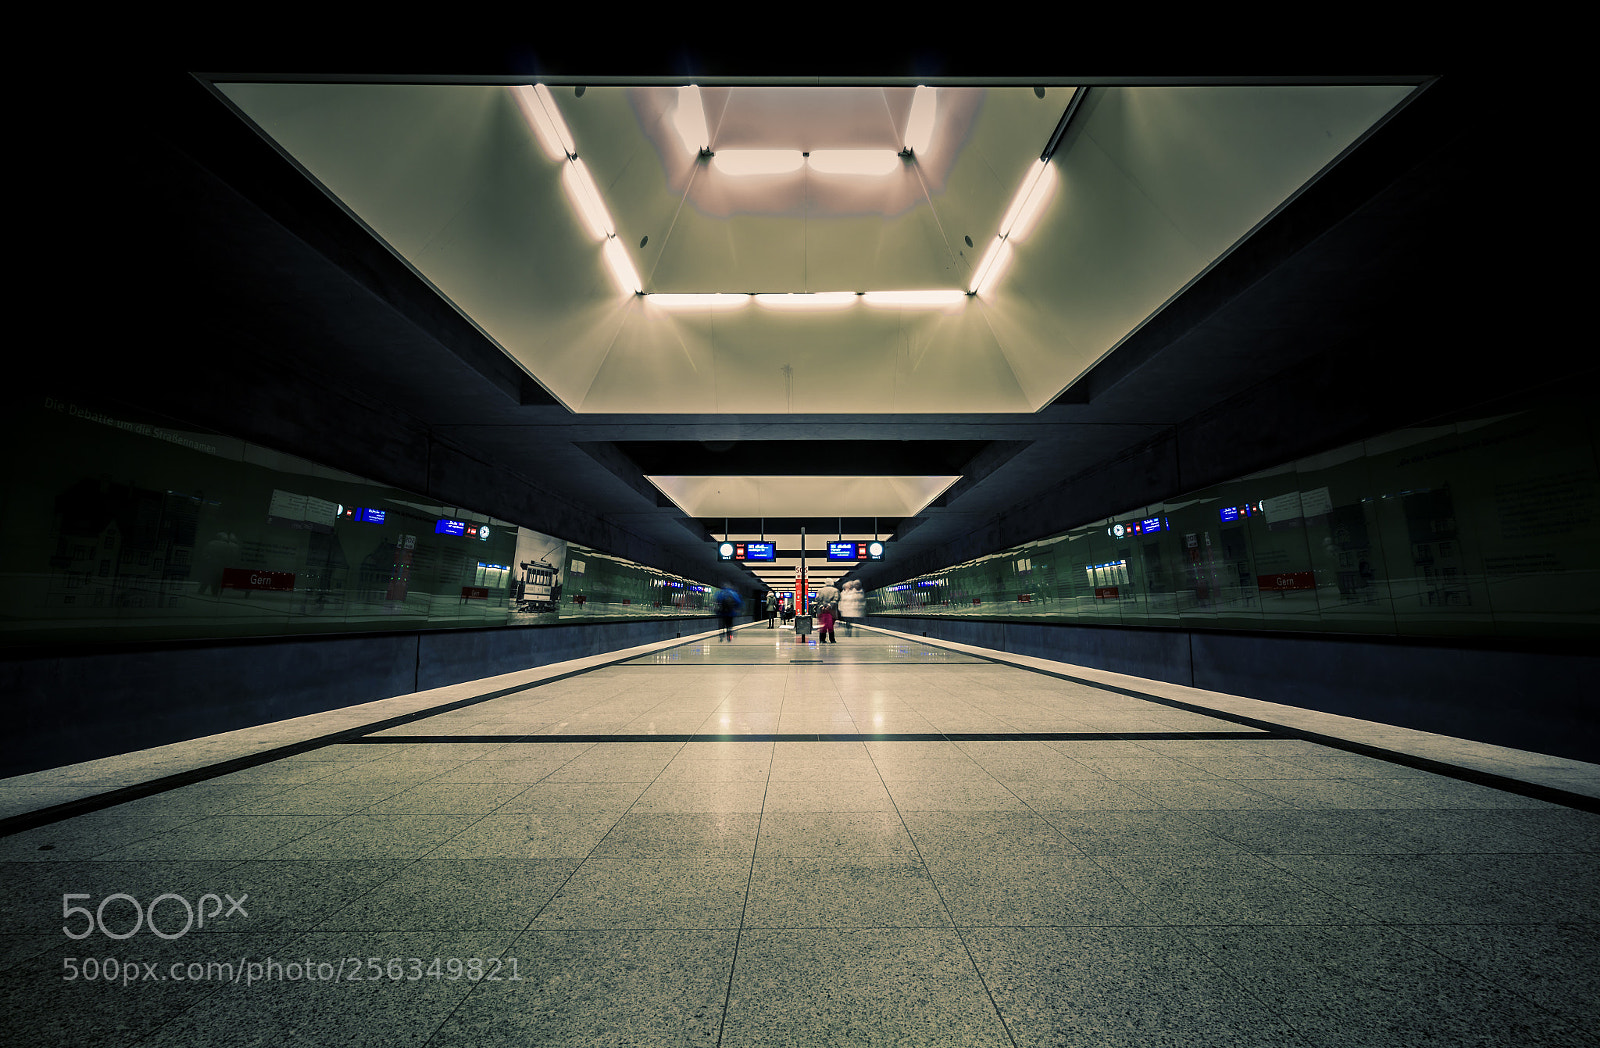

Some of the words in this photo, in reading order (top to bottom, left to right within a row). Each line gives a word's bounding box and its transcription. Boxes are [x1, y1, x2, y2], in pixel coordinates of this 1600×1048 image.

[44, 396, 64, 413] Die
[69, 403, 113, 426] Debatte
[116, 419, 134, 432] um
[135, 423, 152, 437] die
[153, 427, 216, 455] Straßennamen
[250, 574, 272, 585] Gern
[1276, 577, 1295, 586] Gern
